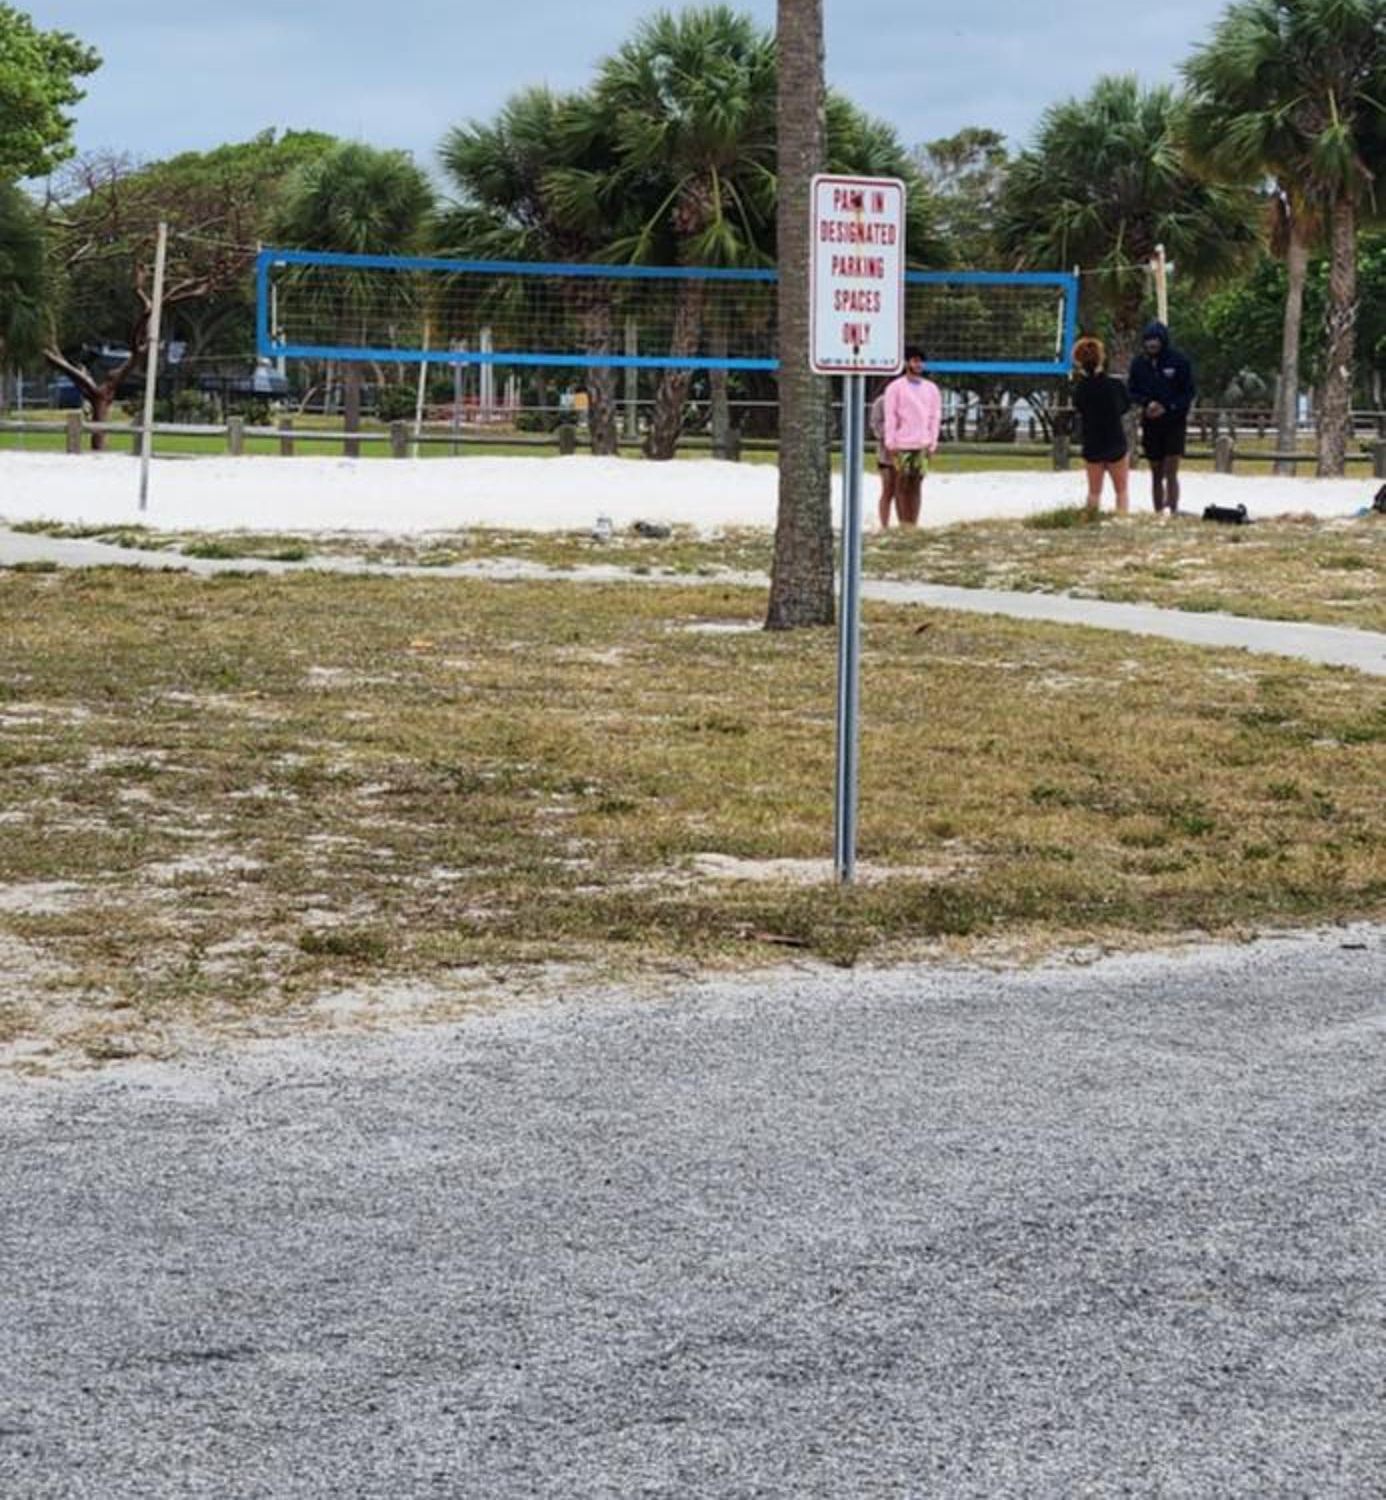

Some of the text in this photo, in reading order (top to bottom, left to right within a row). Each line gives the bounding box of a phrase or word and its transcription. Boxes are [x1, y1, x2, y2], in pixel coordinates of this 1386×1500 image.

[833, 188, 885, 214] PARK IN
[820, 220, 896, 245] DESIGNATED
[831, 255, 885, 279] PARKING
[834, 289, 881, 313] SPACES
[843, 323, 871, 345] ONLY
